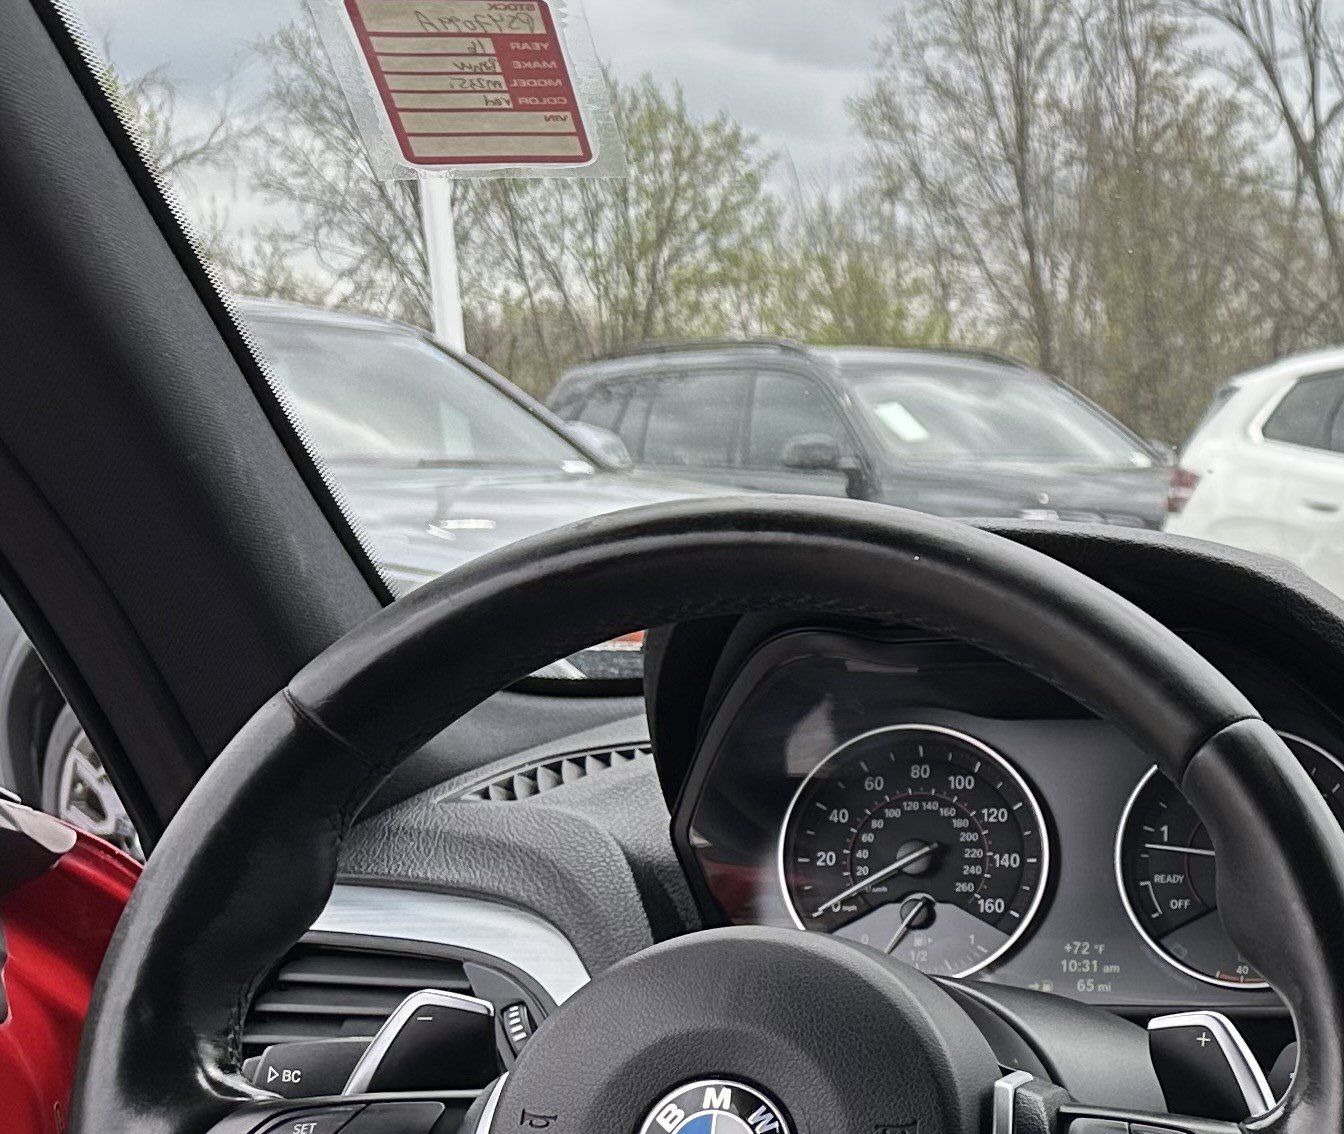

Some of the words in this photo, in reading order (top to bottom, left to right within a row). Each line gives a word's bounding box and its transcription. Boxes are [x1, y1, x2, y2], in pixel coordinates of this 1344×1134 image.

[910, 764, 930, 779] 80
[864, 776, 884, 791] 60
[948, 775, 975, 790] 100
[903, 801, 919, 811] 120
[922, 801, 939, 811] 140
[940, 807, 956, 817] 160
[829, 808, 849, 823] 40
[885, 808, 901, 818] 100
[981, 808, 1008, 823] 120
[871, 819, 884, 829] 80
[861, 832, 874, 842] 60
[960, 832, 979, 842] 200
[1160, 825, 1168, 842] 1
[816, 851, 837, 866] 20
[856, 849, 869, 859] 40
[964, 848, 984, 858] 220
[993, 852, 1020, 868] 140
[856, 866, 869, 876] 20
[963, 865, 982, 875] 240
[1154, 873, 1185, 884] READY
[955, 882, 974, 892] 260
[978, 898, 1005, 913] 160
[1170, 899, 1191, 910] OFF
[1064, 942, 1090, 954] +72
[910, 950, 928, 962] 1/2
[1061, 959, 1099, 973] 10:31
[1103, 963, 1120, 974] am
[1236, 965, 1249, 975] 40
[1077, 978, 1094, 992] 65
[1097, 982, 1111, 992] mi
[282, 1069, 301, 1083] BC
[655, 1086, 780, 1134] BMW
[292, 1122, 317, 1134] SET
